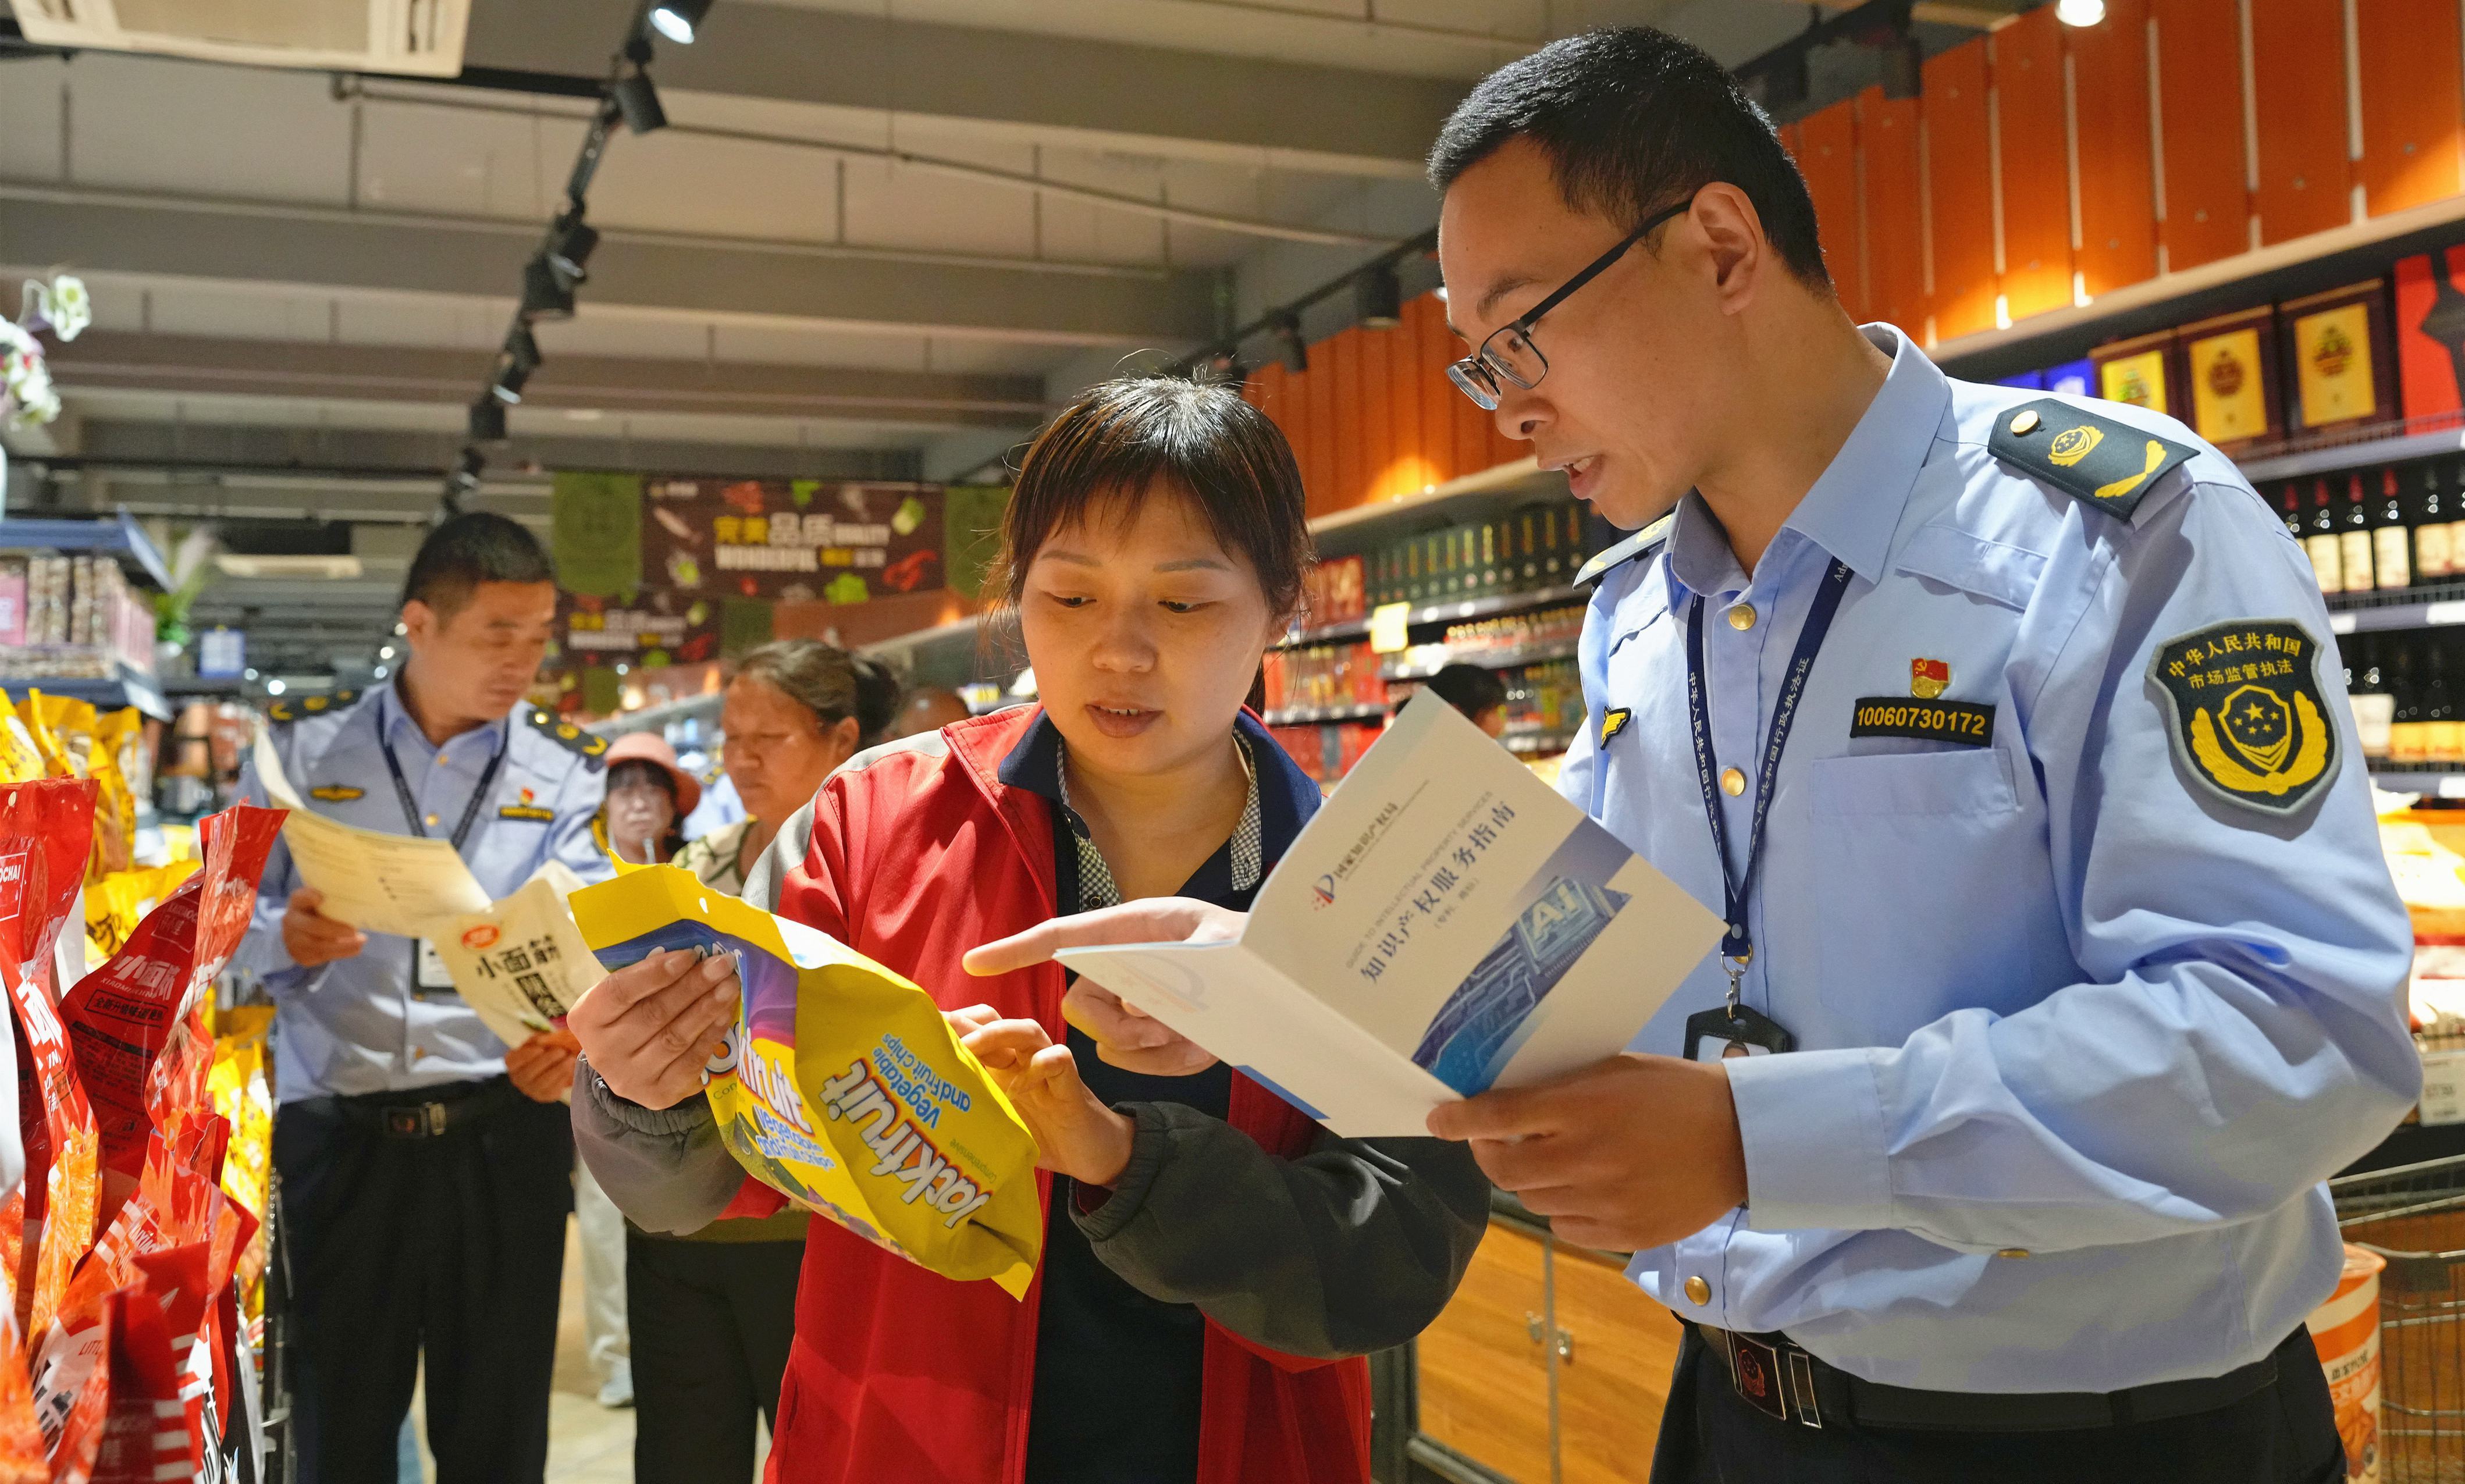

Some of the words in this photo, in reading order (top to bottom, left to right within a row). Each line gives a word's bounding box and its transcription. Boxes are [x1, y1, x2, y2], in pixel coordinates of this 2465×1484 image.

[2168, 632, 2302, 677] 中华人民共和国
[2188, 659, 2294, 689] 市场监管执法
[1748, 656, 1810, 862] 人民共和国行政执法证
[1858, 706, 1986, 736] 10060730172
[1688, 671, 1723, 862] 中华人民共和国行政执
[1360, 801, 1516, 984] 知识产权服务指南
[1532, 883, 1578, 941] AI
[873, 1048, 941, 1129] Vegetable
[819, 1059, 991, 1229] Jackfruit
